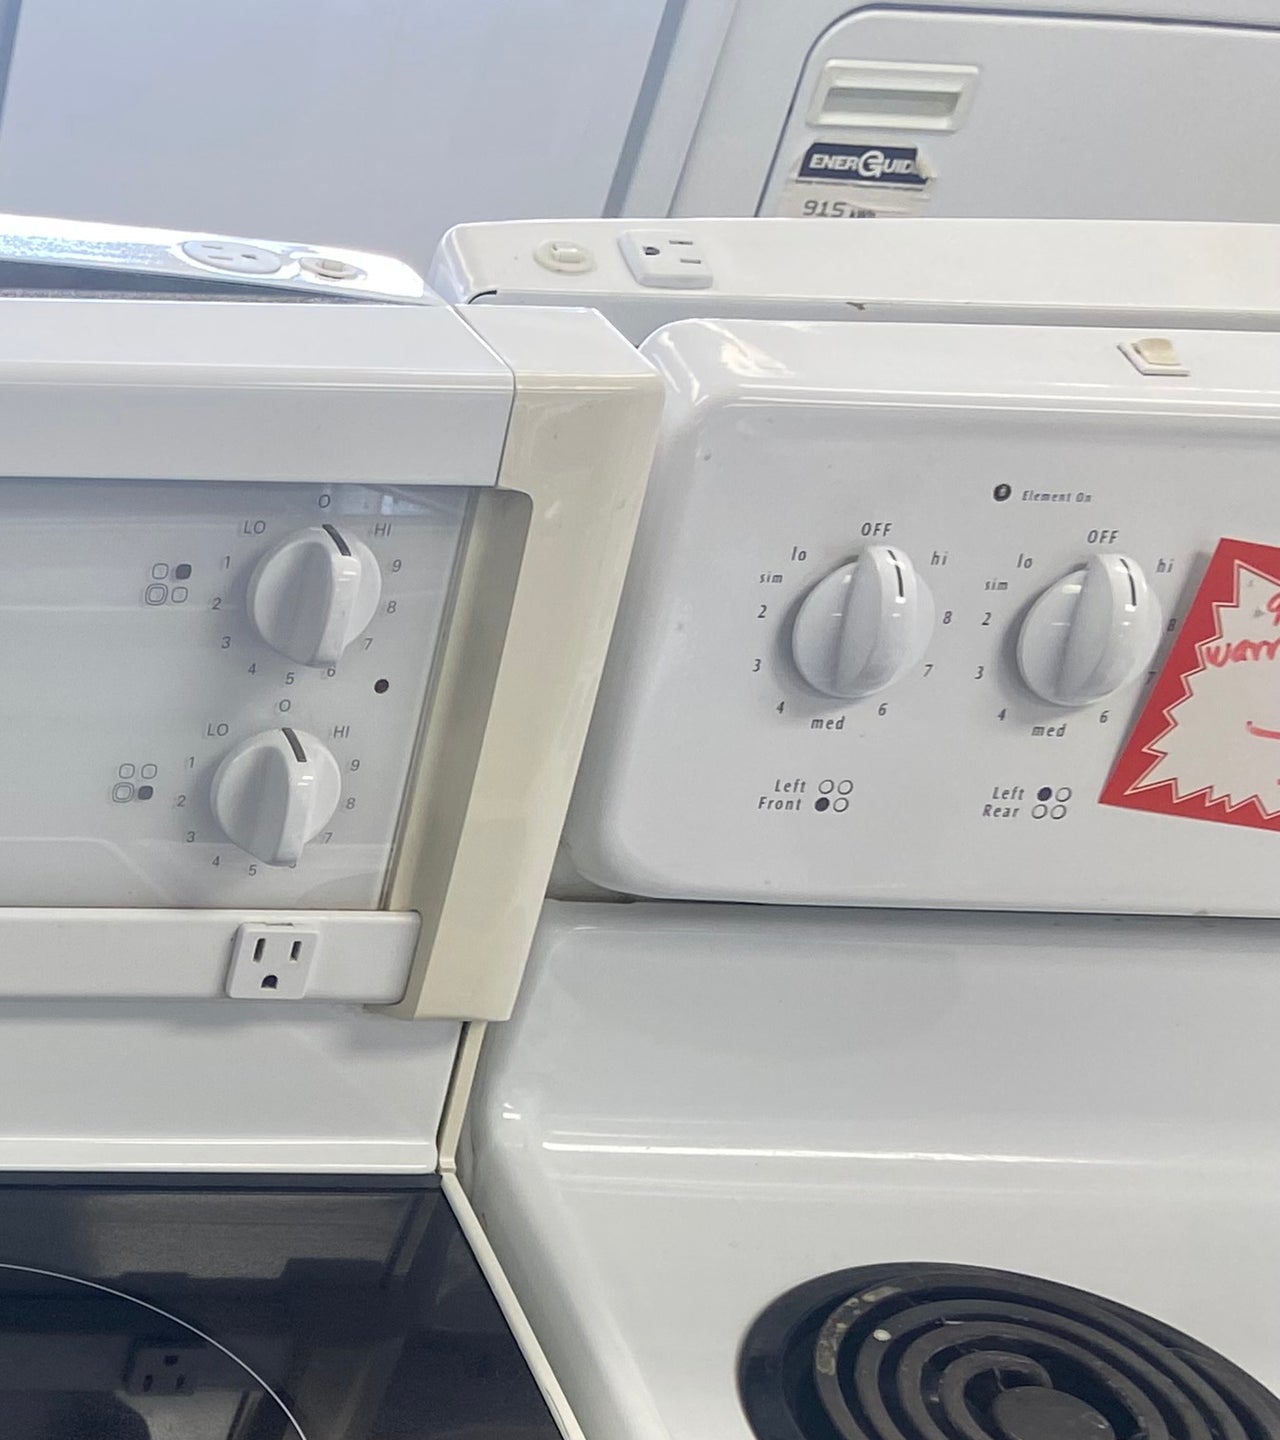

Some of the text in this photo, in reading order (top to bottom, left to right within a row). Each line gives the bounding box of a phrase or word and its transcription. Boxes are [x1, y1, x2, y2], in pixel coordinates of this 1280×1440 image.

[808, 150, 917, 178] ENERGUID
[1022, 490, 1092, 503] Element On
[243, 520, 266, 535] LO
[373, 523, 392, 537] HI
[861, 522, 893, 537] OFF
[1087, 529, 1119, 544] OFF
[791, 546, 807, 561] lo
[930, 551, 948, 566] hi
[392, 559, 402, 573] 9
[1016, 553, 1033, 569] lo
[1156, 558, 1174, 573] hi
[759, 572, 783, 584] sim
[984, 579, 1008, 591] sim
[211, 597, 222, 611] 2
[386, 601, 397, 614] 8
[757, 605, 767, 618] 2
[942, 611, 952, 624] 8
[981, 612, 991, 626] 2
[1166, 618, 1177, 632] 8
[221, 636, 232, 649] 3
[363, 637, 373, 650] 7
[247, 663, 257, 676] 4
[752, 659, 762, 672] 3
[923, 664, 934, 678] 7
[974, 665, 984, 680] 3
[285, 672, 295, 685] 5
[1146, 671, 1157, 685] 7
[776, 701, 785, 714] 4
[878, 702, 888, 716] 6
[997, 708, 1007, 722] 4
[1099, 710, 1109, 724] 6
[810, 715, 845, 730] med
[207, 723, 229, 737] LO
[333, 725, 350, 738] HI
[1031, 723, 1066, 738] med
[350, 759, 360, 772] 9
[774, 779, 806, 793] Left
[992, 786, 1025, 800] Left
[176, 795, 186, 808] 2
[346, 797, 356, 810] 8
[758, 796, 801, 811] Front
[983, 805, 1020, 819] Rear
[186, 831, 196, 843] 3
[324, 832, 333, 844] 7
[211, 856, 220, 867] 4
[248, 864, 257, 876] 5
